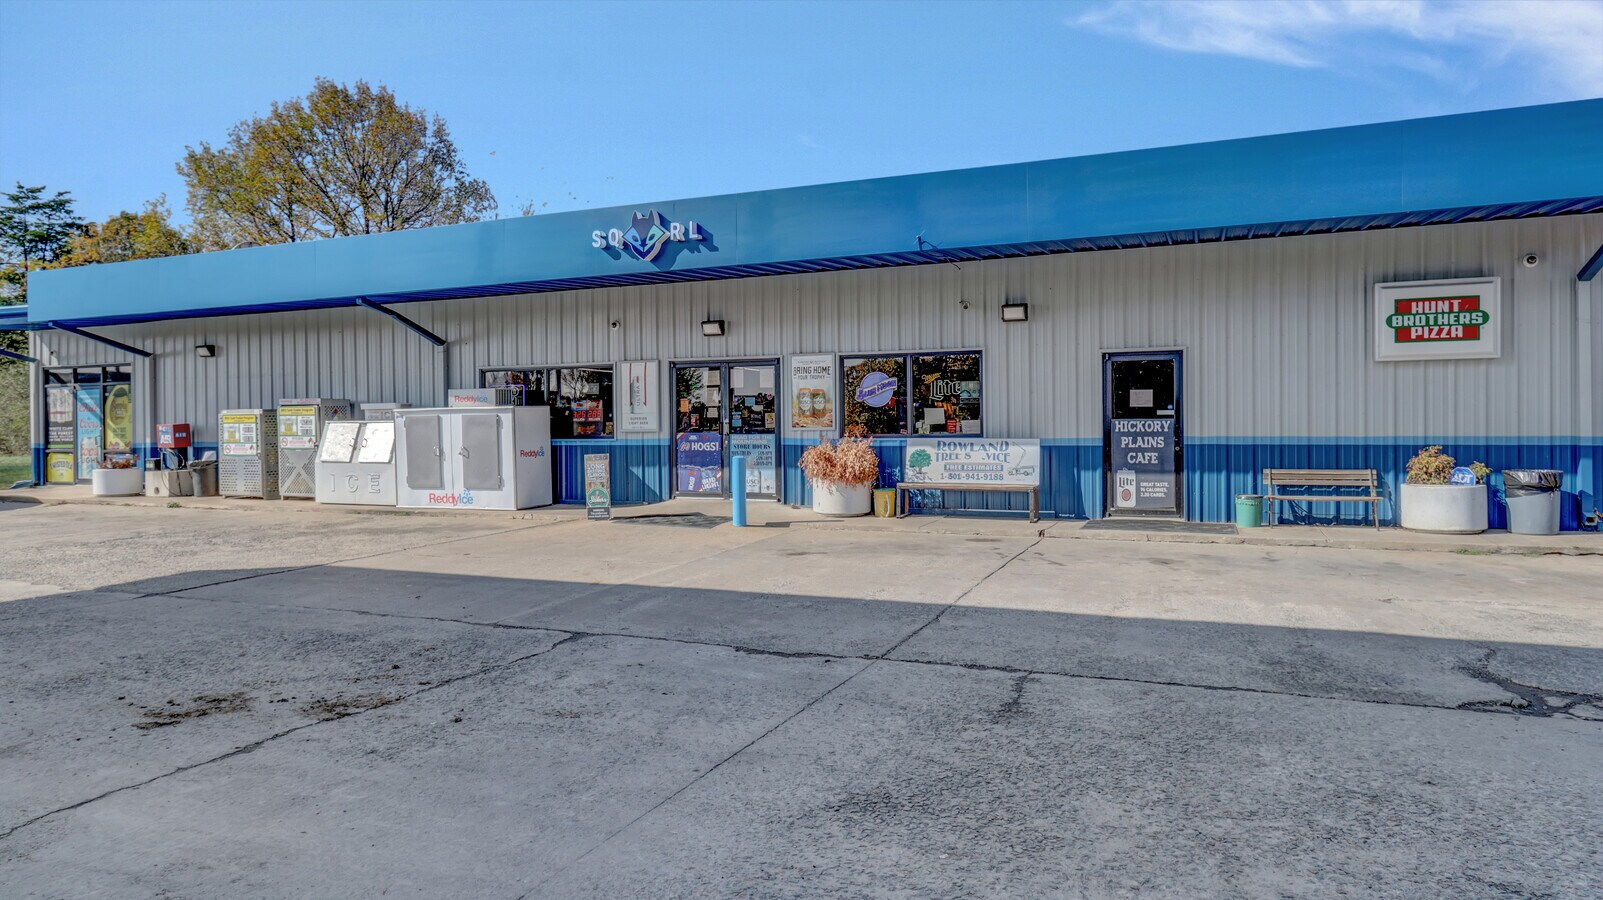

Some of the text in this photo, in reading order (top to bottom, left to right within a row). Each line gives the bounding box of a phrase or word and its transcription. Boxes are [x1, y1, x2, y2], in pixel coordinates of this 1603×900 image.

[1411, 299, 1461, 314] HUNT
[1391, 312, 1483, 327] BROTHERS
[1410, 325, 1463, 340] PIZZA
[813, 366, 831, 375] HOME
[1114, 420, 1171, 432] HICKORY
[691, 441, 719, 451] HOGS!
[936, 440, 1010, 452] ROWLAND
[1120, 437, 1165, 448] PLAINS
[934, 452, 961, 462] TREE
[1127, 452, 1159, 464] CAFE
[1118, 476, 1135, 488] Lite
